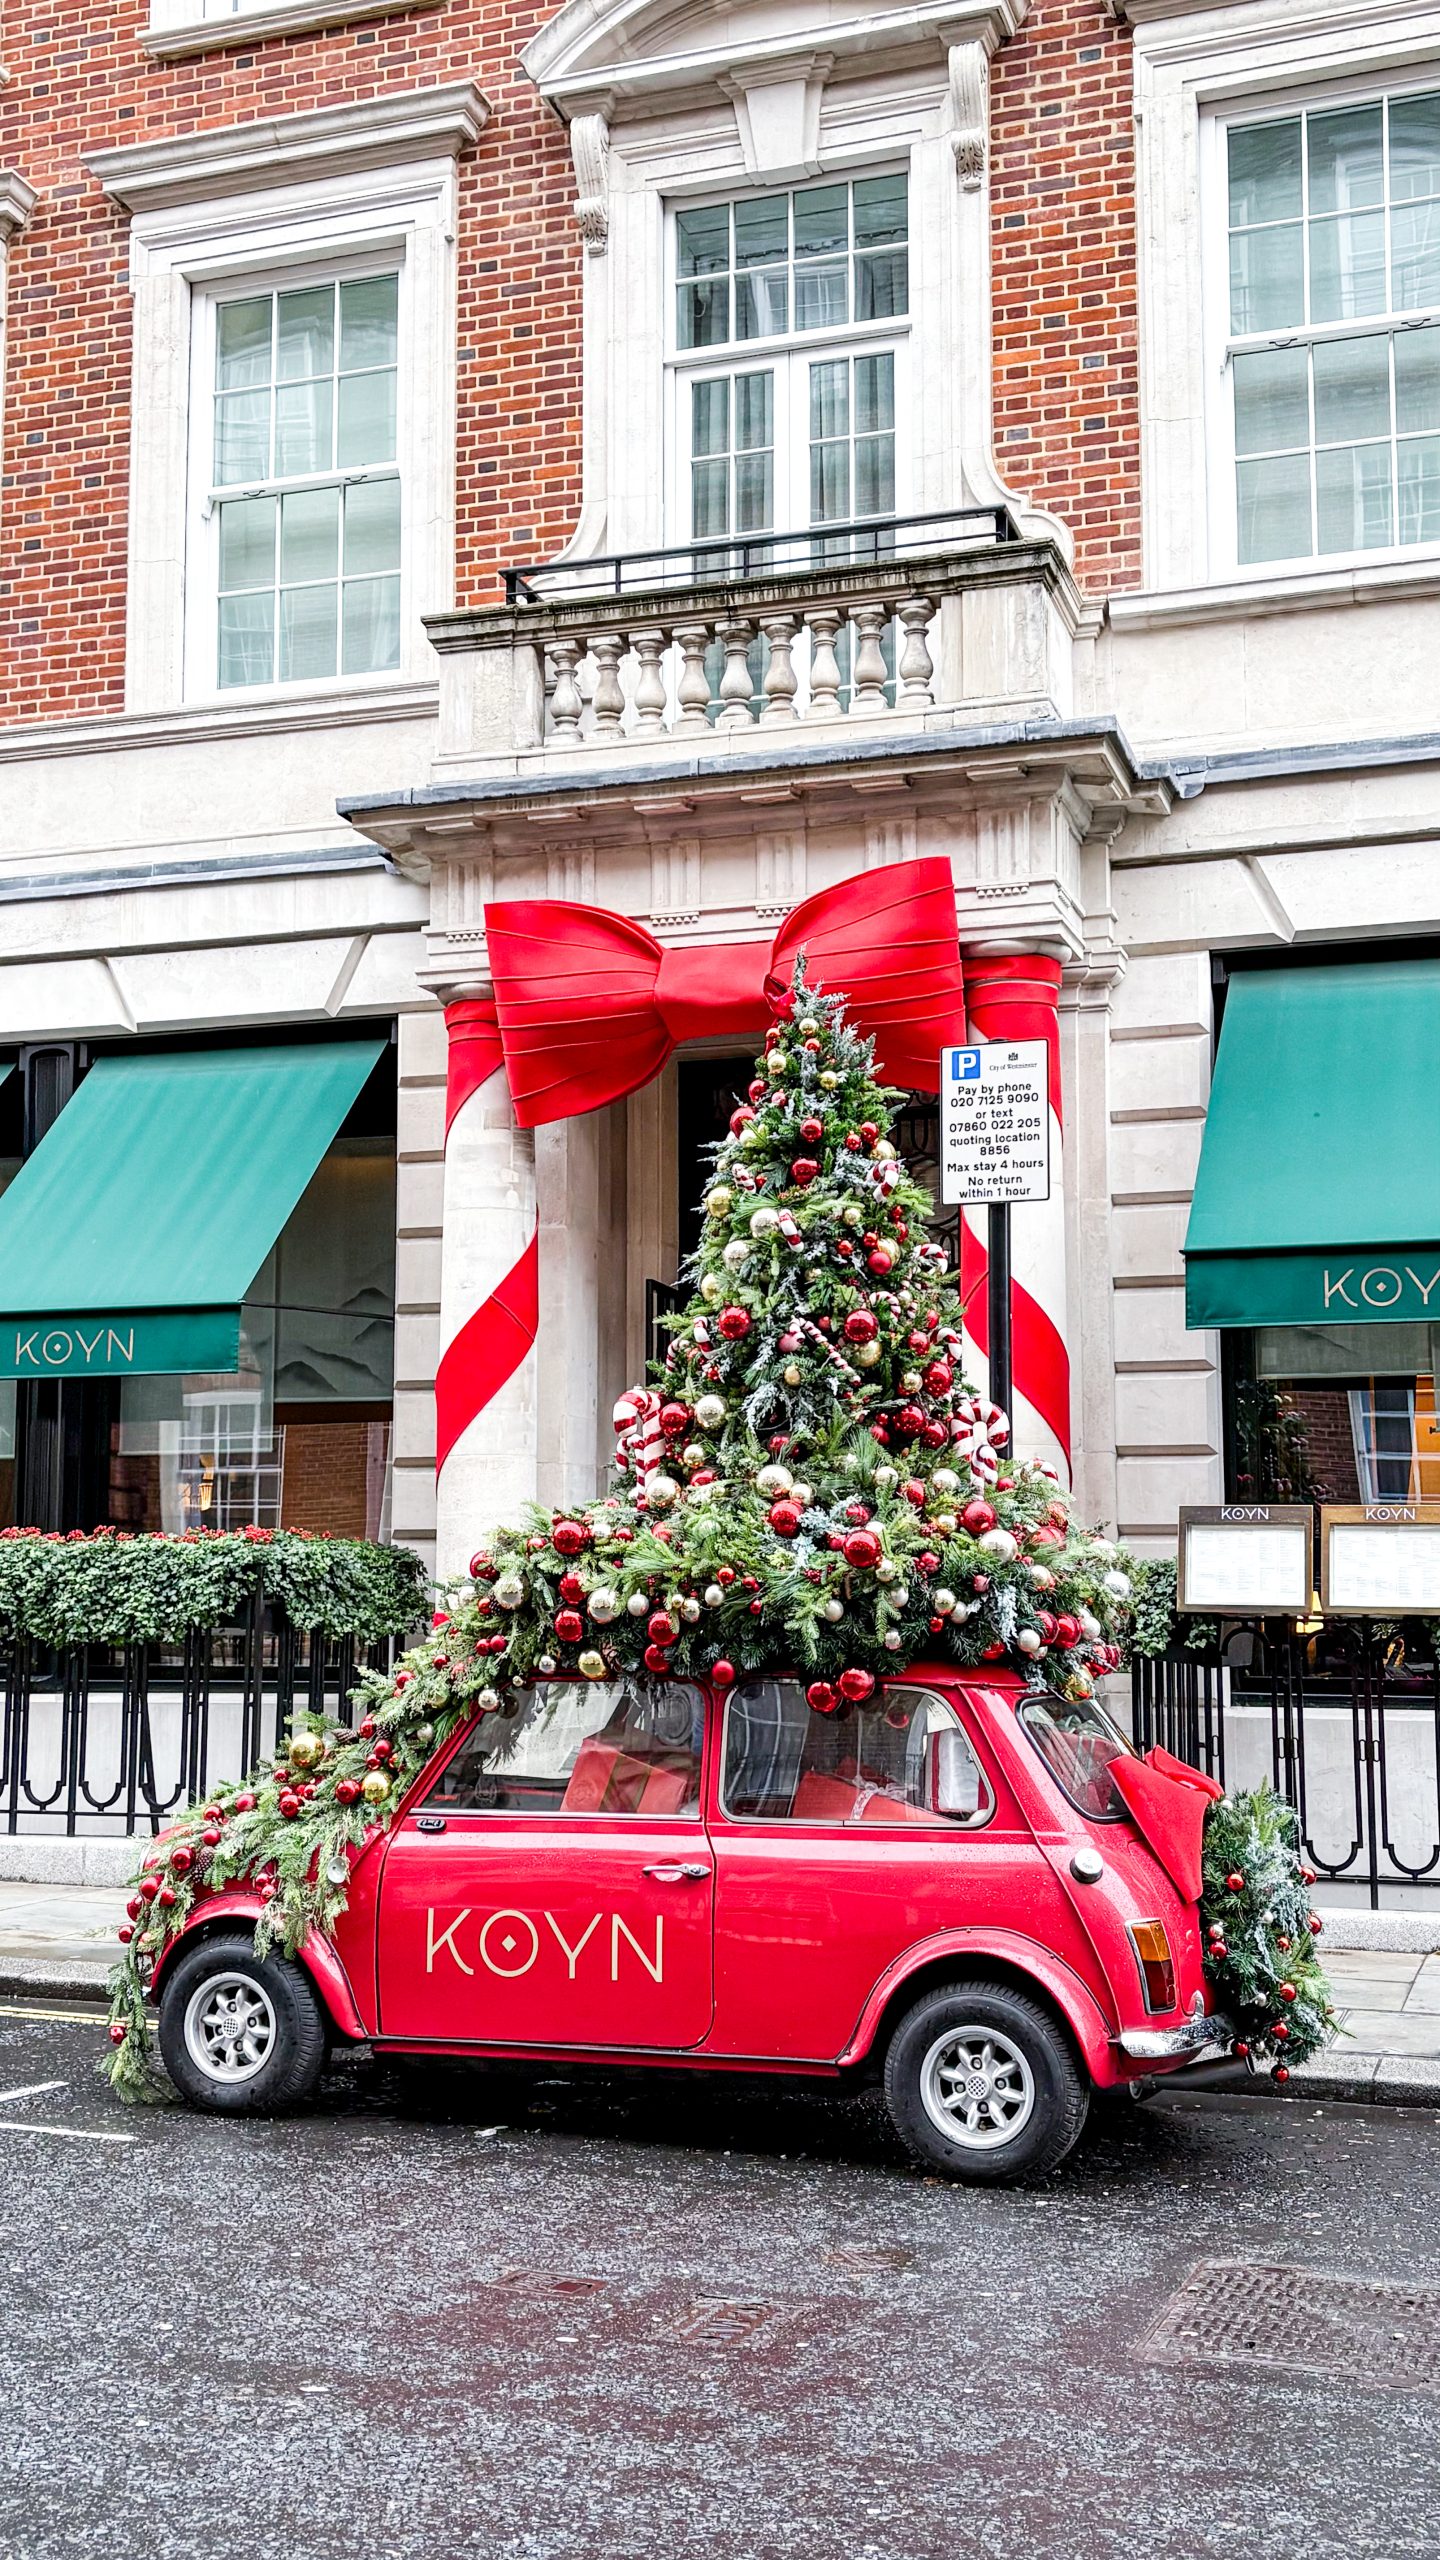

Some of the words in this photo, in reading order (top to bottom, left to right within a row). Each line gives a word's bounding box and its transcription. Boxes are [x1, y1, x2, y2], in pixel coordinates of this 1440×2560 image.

[959, 1053, 976, 1077] P
[958, 1086, 977, 1096] Pay
[982, 1085, 994, 1094] by
[998, 1083, 1031, 1092] phone
[951, 1098, 973, 1107] 020
[978, 1095, 1003, 1105] 7125
[1008, 1093, 1038, 1103] 9090
[976, 1111, 986, 1119] or
[991, 1108, 1013, 1118] text
[950, 1122, 986, 1132] 07860
[991, 1120, 1013, 1129] 022
[1018, 1118, 1040, 1127] 205
[950, 1135, 991, 1146] quoting
[996, 1132, 1040, 1143] location
[980, 1145, 1010, 1155] 8856
[947, 1163, 969, 1172] Max
[974, 1161, 996, 1171] stay
[1000, 1160, 1008, 1168] 4
[1012, 1158, 1044, 1168] hours
[968, 1177, 983, 1186] No
[988, 1175, 1022, 1185] return
[959, 1188, 993, 1198] within
[997, 1188, 1001, 1196] 1
[1006, 1186, 1031, 1196] hour
[16, 1328, 134, 1365] KOYN
[1221, 1507, 1269, 1520] KOYN
[1366, 1507, 1416, 1520] KOYN
[426, 1907, 664, 1983] KOYN
